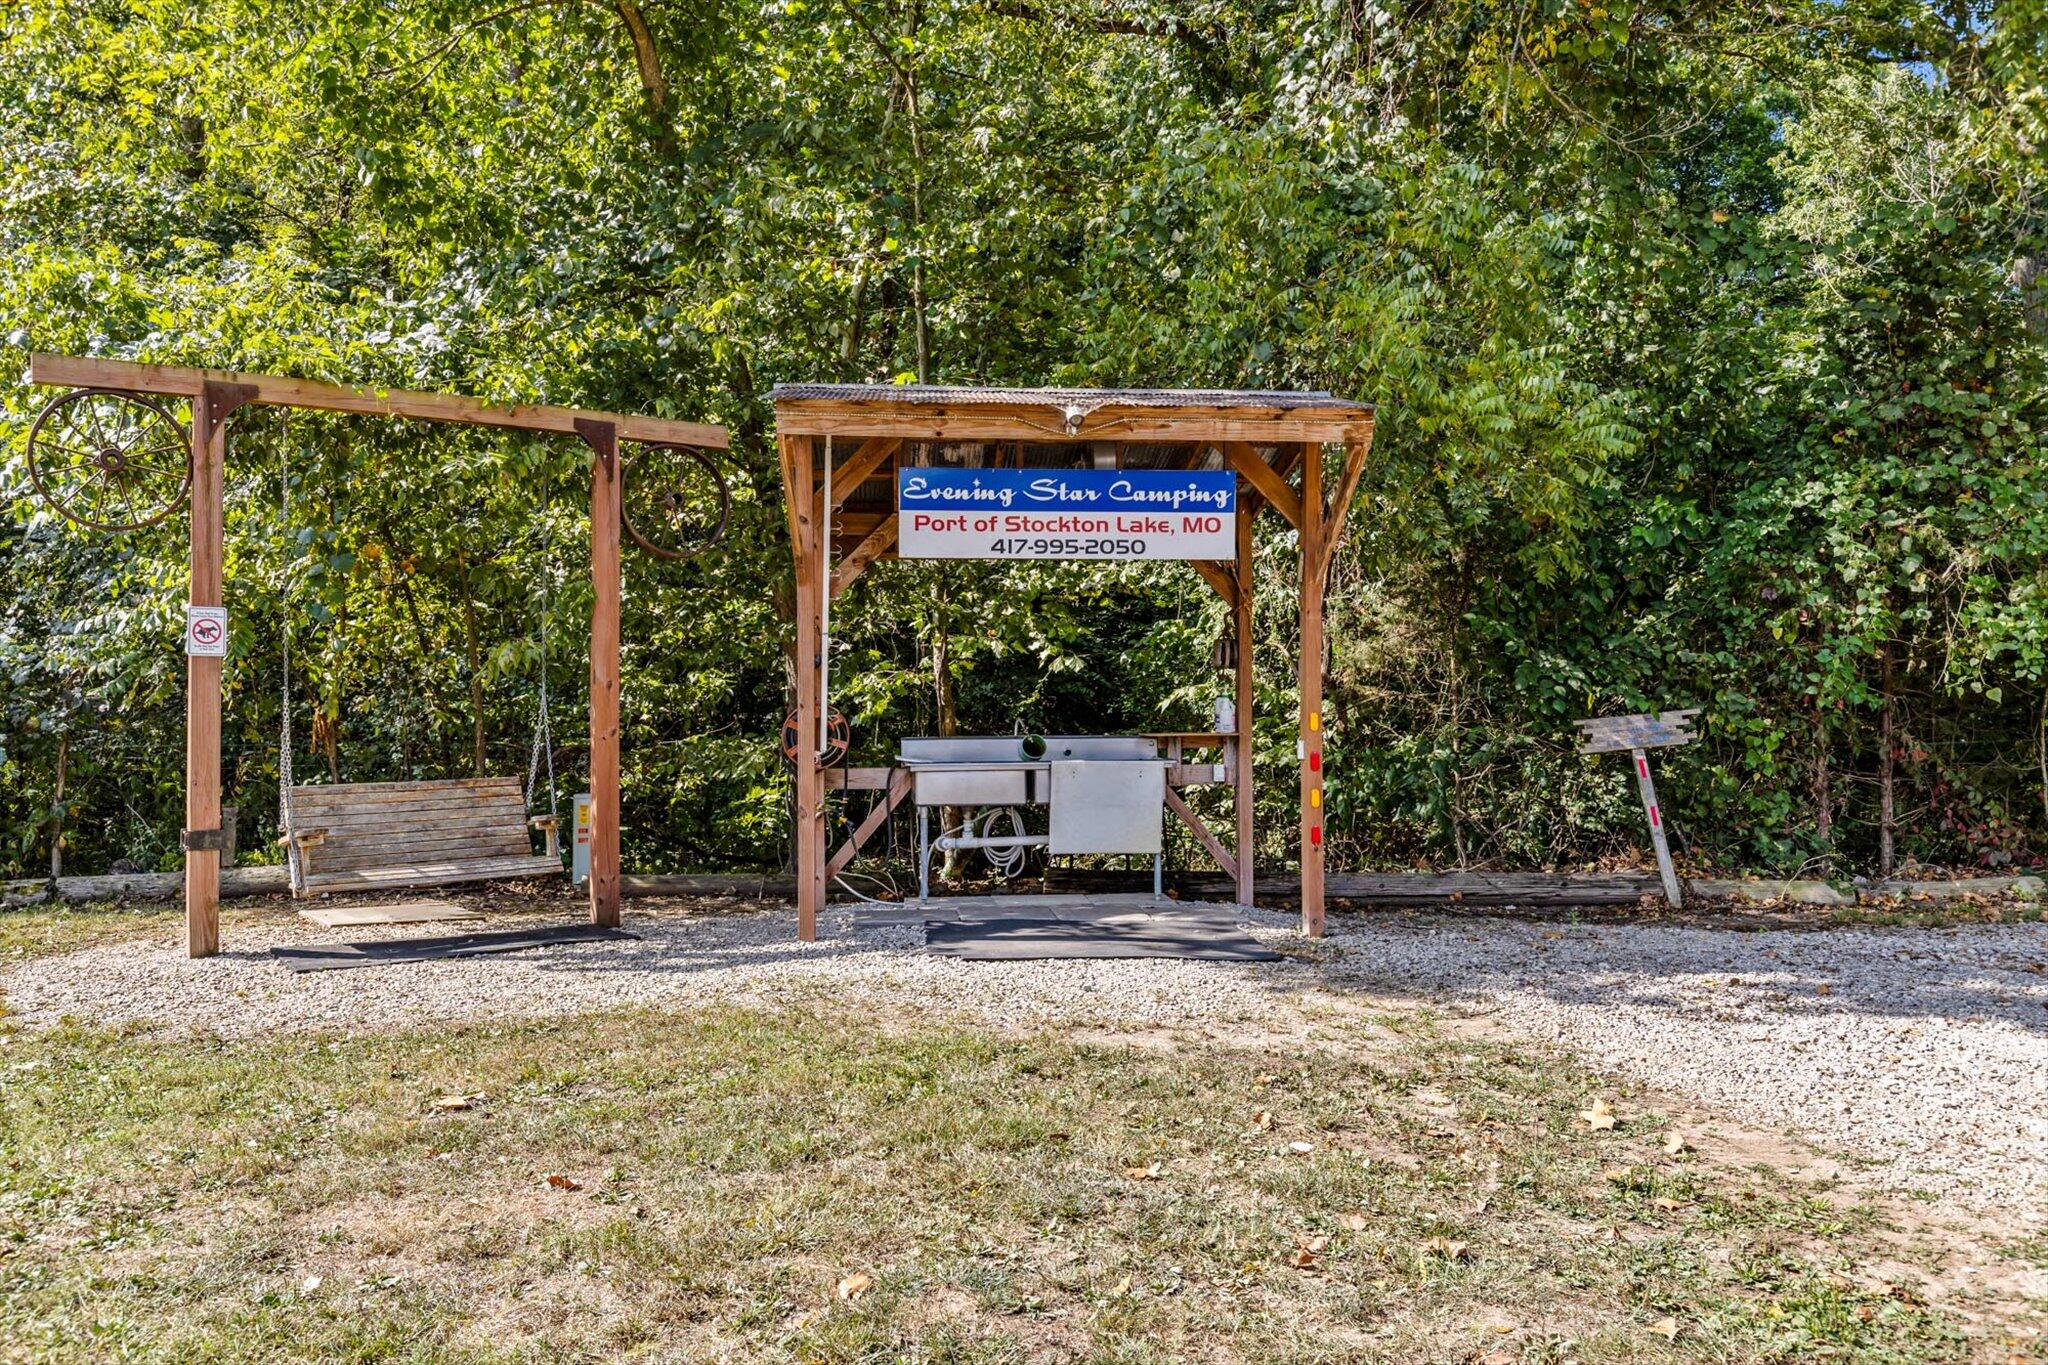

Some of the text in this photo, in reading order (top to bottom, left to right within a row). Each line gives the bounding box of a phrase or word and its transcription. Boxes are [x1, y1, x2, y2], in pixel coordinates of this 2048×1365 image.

[903, 477, 1232, 509] Evening Star Camping
[914, 515, 1221, 535] Port of Stockton Lake, MO
[990, 538, 1146, 555] 417-995-2050
